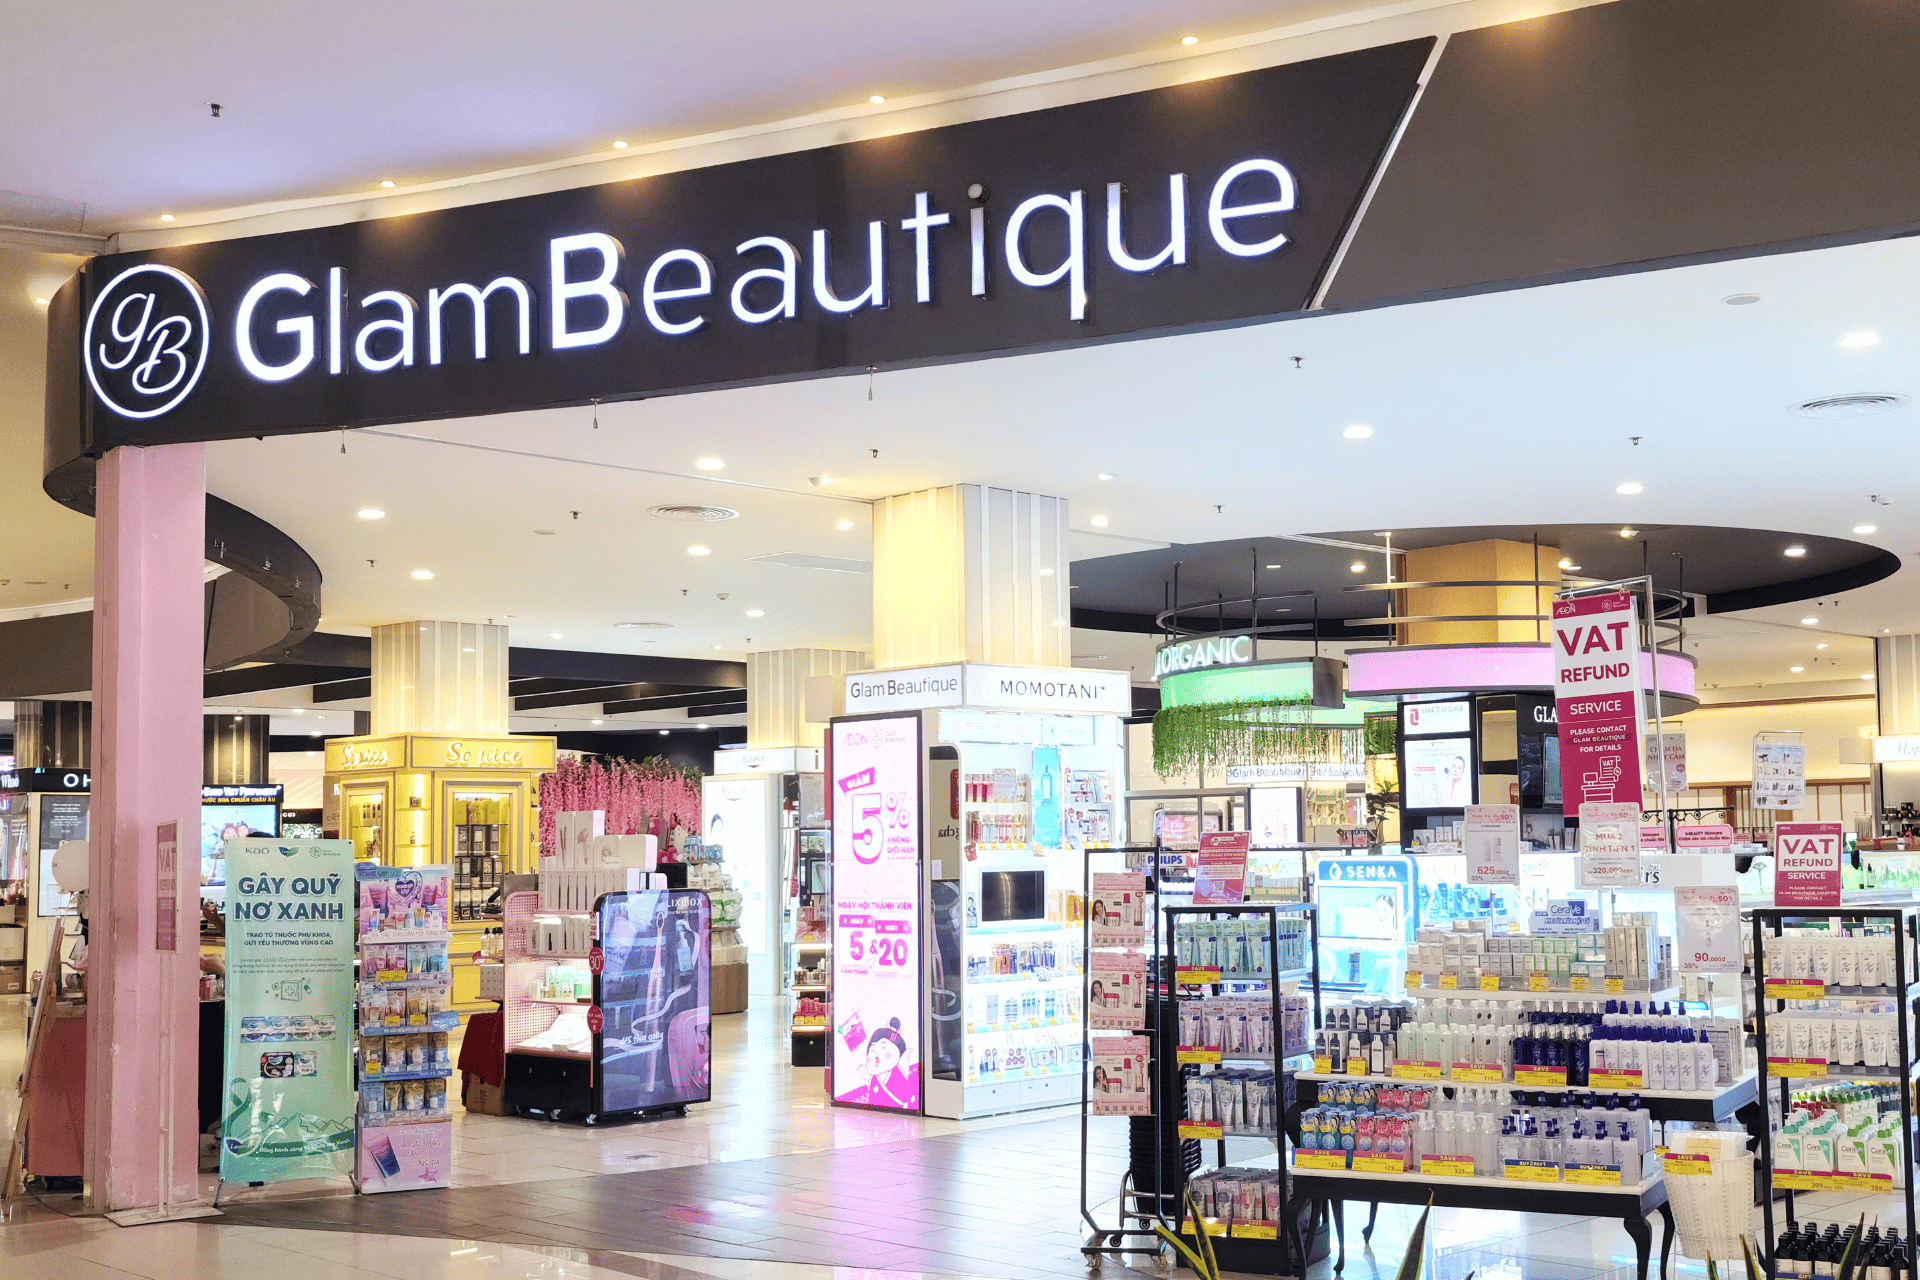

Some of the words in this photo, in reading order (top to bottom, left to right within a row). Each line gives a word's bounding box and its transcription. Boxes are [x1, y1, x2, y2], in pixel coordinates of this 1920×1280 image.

[1557, 621, 1629, 656] VAT
[1162, 635, 1250, 673] ORGANIC
[1560, 662, 1630, 684] REFUND
[1570, 699, 1622, 715] SERVICE
[1570, 727, 1595, 735] PLEASE
[1596, 724, 1627, 733] CONTACT
[1592, 733, 1626, 742] BEAUTIQUE
[445, 743, 471, 764] So
[1594, 743, 1622, 751] DETAILS
[1783, 838, 1835, 854] VAT
[1783, 858, 1833, 867] REFUND
[1346, 865, 1397, 879] SENKA
[1787, 872, 1826, 880] SERVICE
[238, 872, 285, 895] GÂY
[291, 873, 341, 895] QUỸ
[235, 901, 272, 920] NƠ
[277, 902, 343, 920] XANH
[1550, 904, 1582, 915] CeraVe
[275, 930, 297, 938] THUỐC
[850, 931, 864, 960] 5
[879, 937, 908, 966] 20
